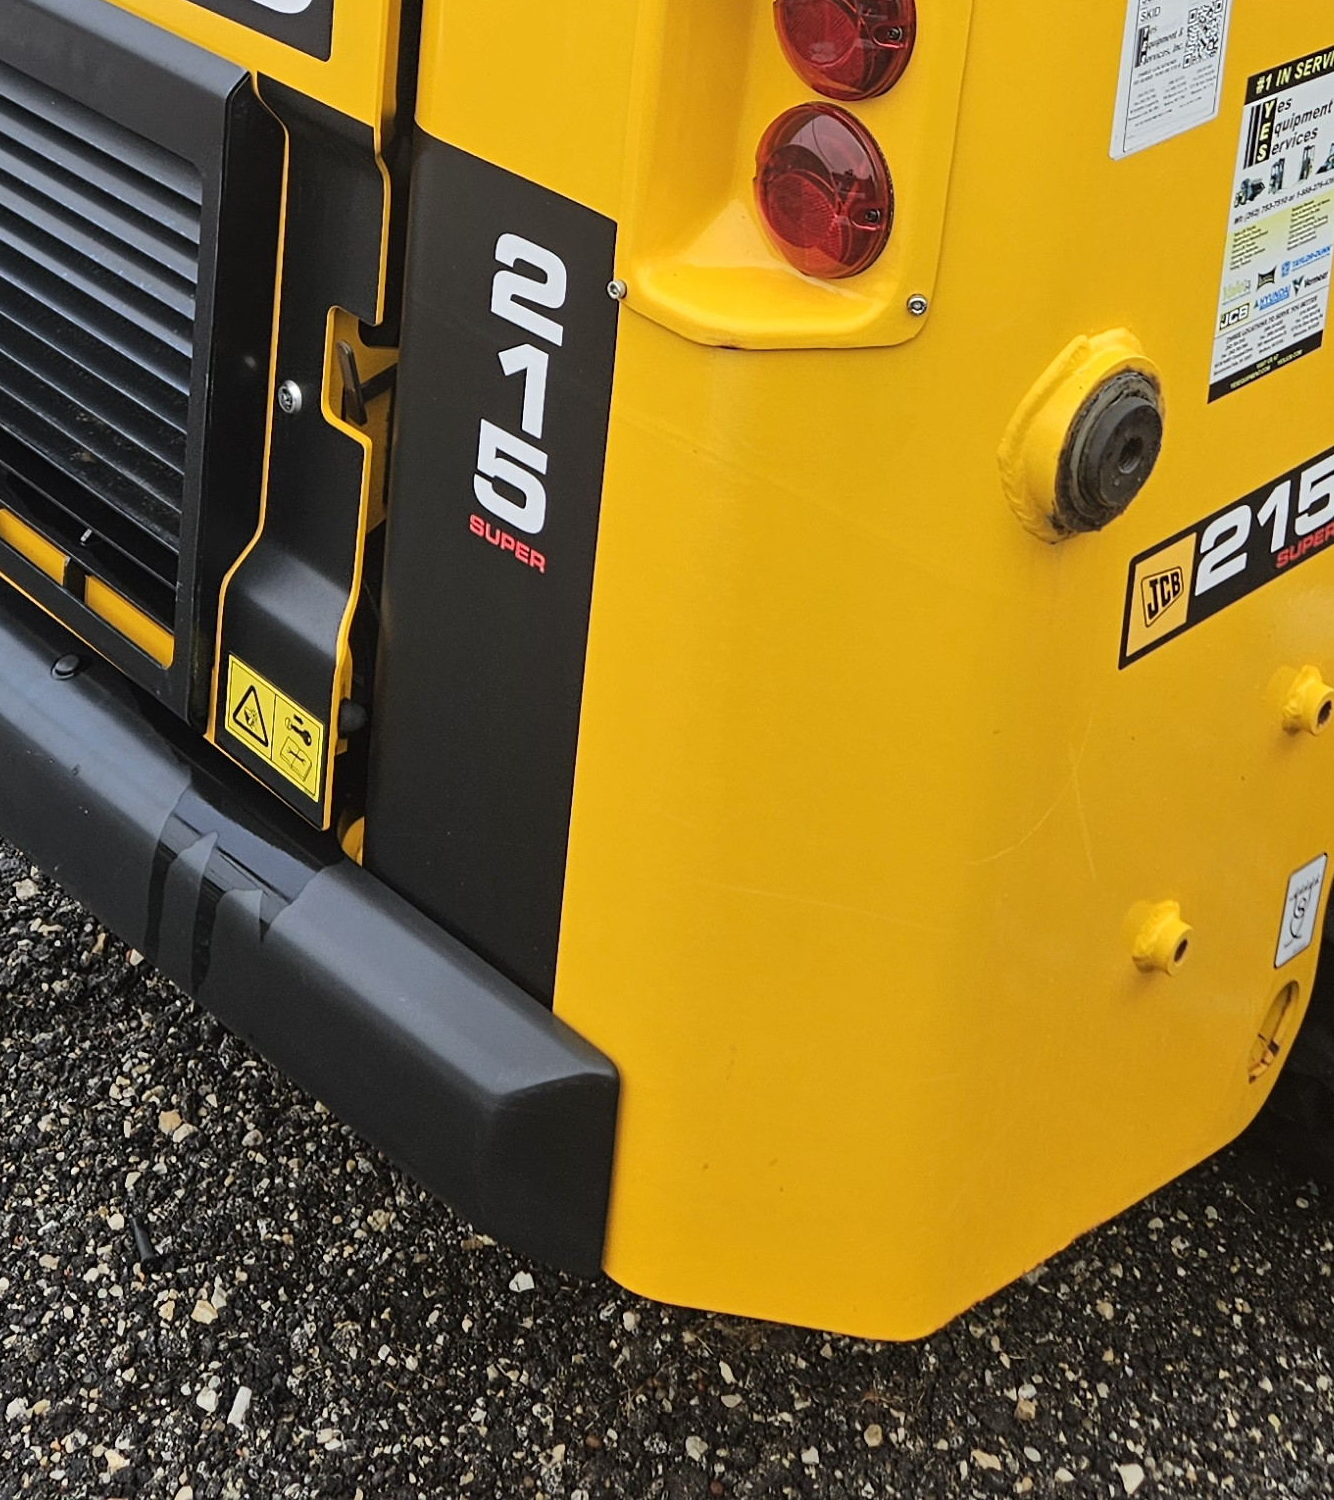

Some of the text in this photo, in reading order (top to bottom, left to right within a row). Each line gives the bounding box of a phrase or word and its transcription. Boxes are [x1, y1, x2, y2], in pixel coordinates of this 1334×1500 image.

[1140, 6, 1161, 22] SKID
[1255, 73, 1272, 94] #1
[1276, 66, 1292, 87] IN
[1220, 304, 1249, 330] JCB
[473, 233, 567, 535] 215
[469, 513, 545, 573] SUPER
[1147, 571, 1181, 620] JCB
